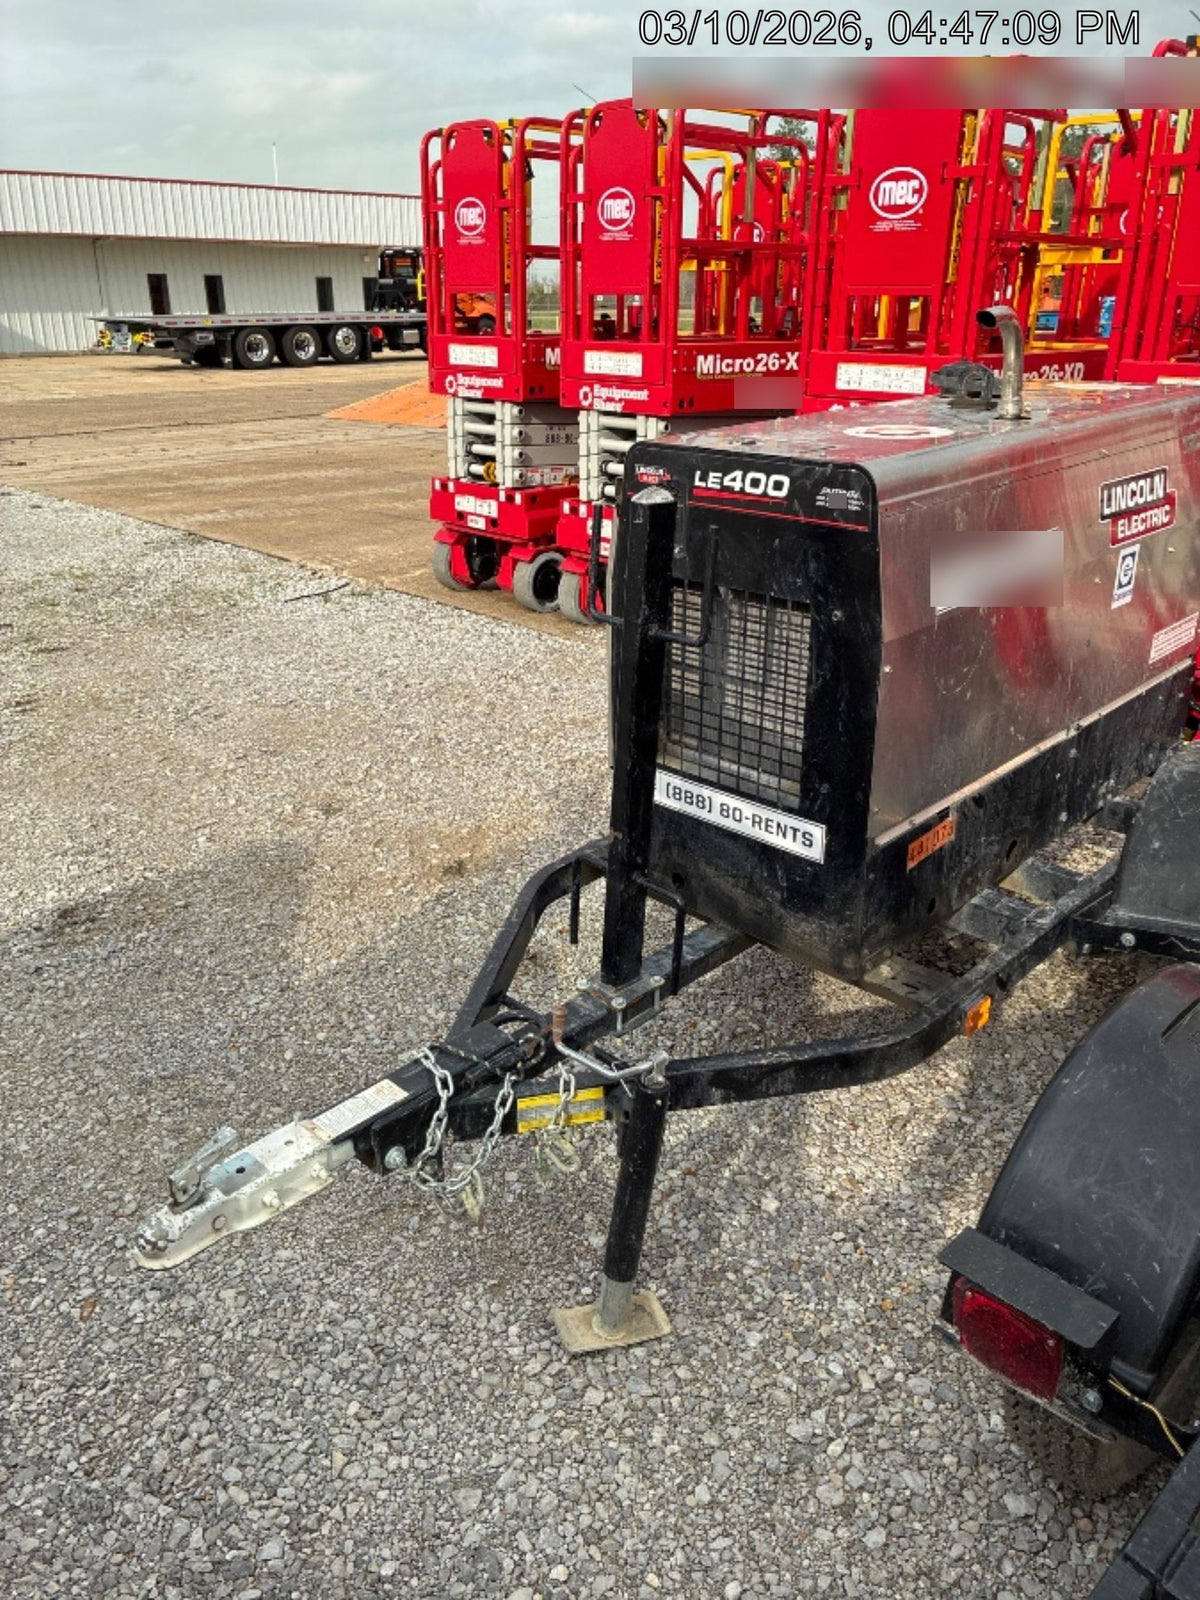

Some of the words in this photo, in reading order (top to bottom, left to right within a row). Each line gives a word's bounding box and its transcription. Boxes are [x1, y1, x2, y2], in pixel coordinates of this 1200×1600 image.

[593, 384, 649, 401] Equipment
[694, 470, 790, 498] LE400
[1103, 473, 1165, 515] LINCOLN
[1117, 504, 1171, 539] ELECTRIC
[666, 782, 712, 813] (888)
[719, 804, 815, 849] 80-RENTS
